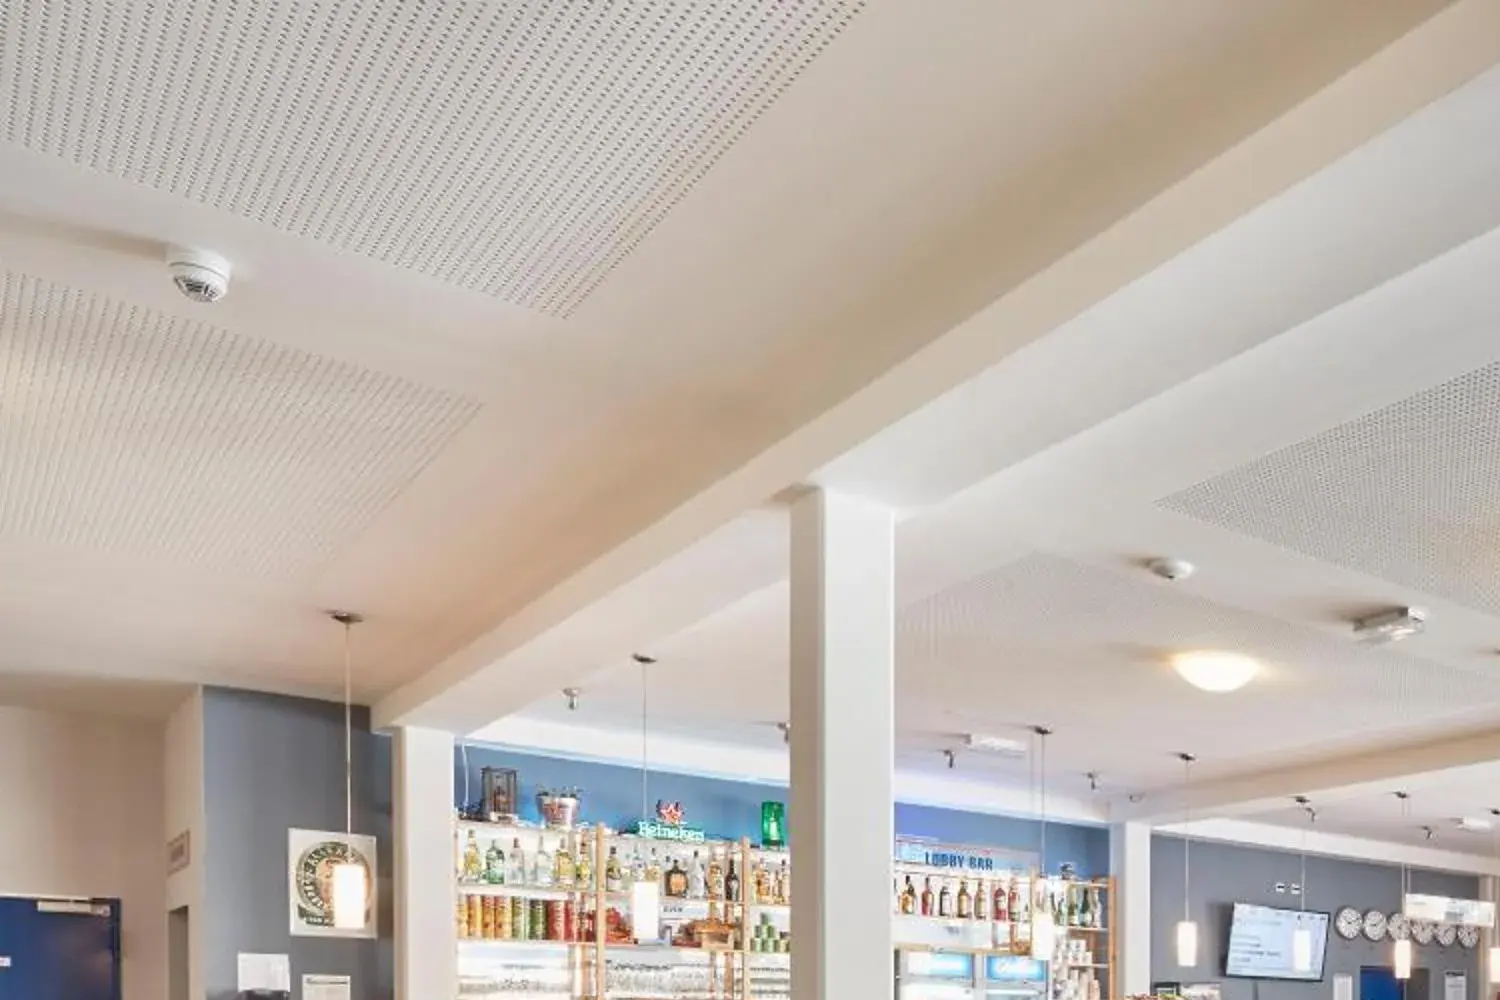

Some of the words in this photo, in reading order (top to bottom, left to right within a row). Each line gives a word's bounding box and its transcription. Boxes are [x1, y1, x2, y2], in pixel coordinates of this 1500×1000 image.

[638, 821, 705, 844] Heineken
[925, 851, 965, 868] LOBBY
[970, 855, 993, 871] BAR
